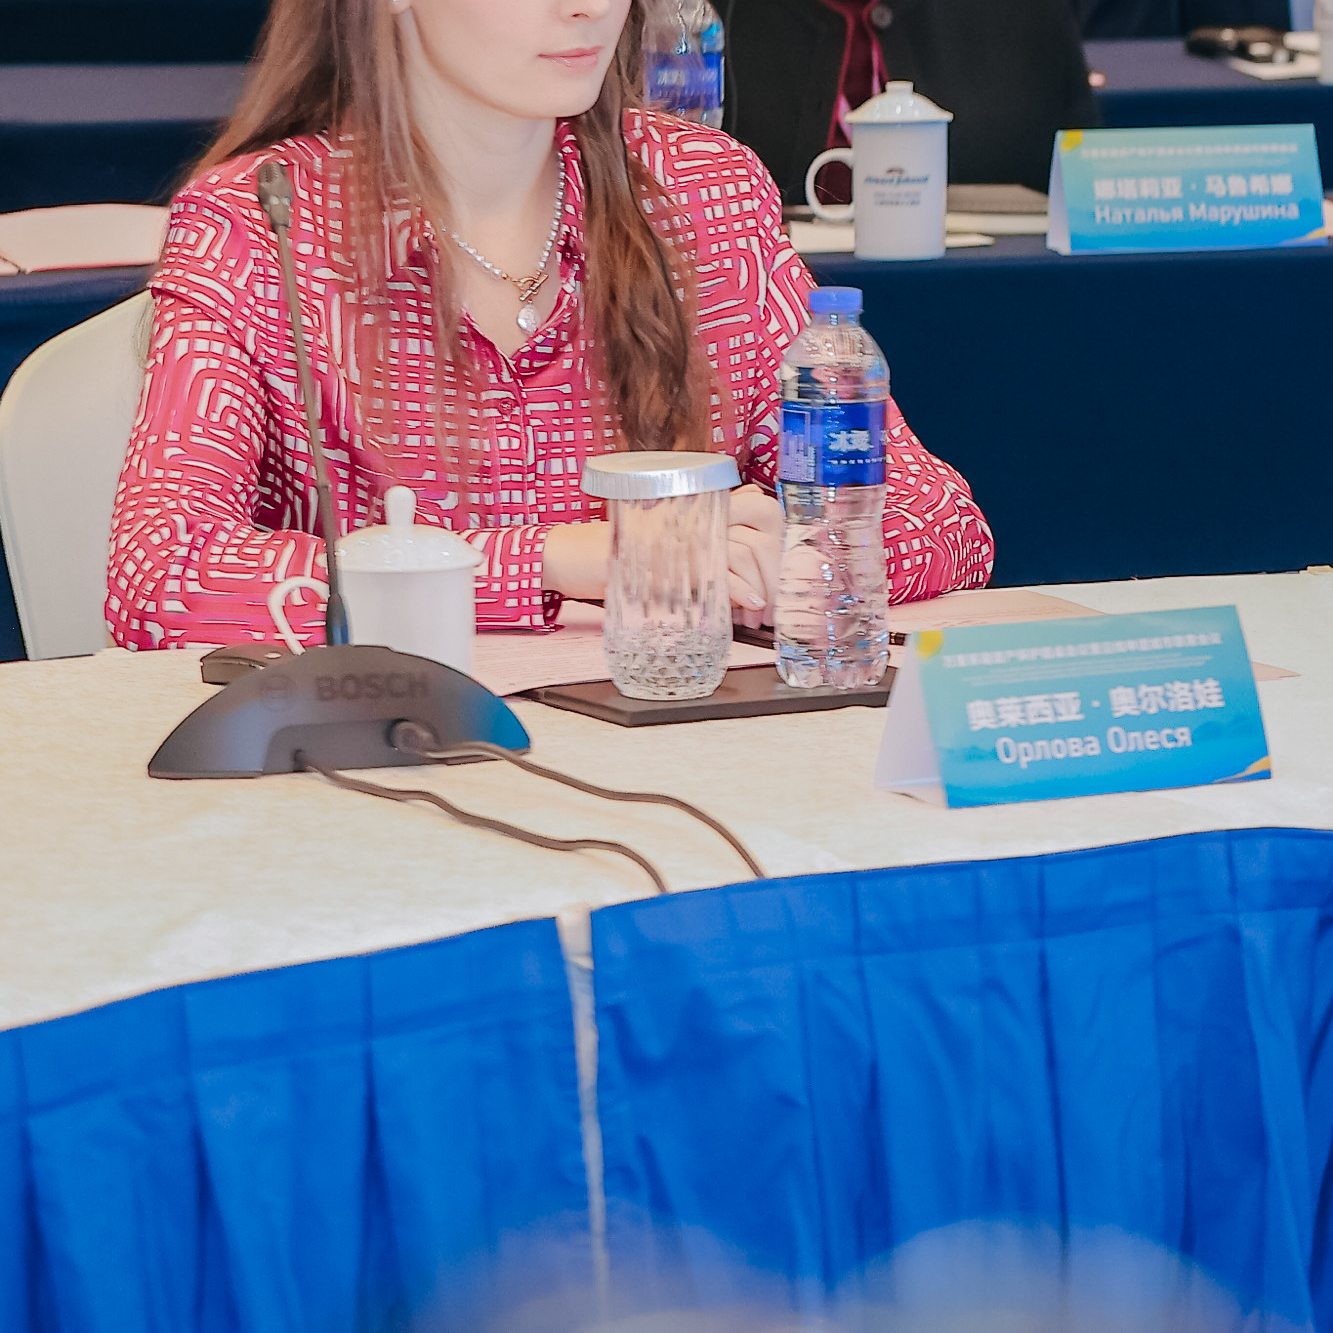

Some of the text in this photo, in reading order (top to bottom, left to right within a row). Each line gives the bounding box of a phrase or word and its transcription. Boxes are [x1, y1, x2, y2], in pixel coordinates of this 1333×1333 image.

[1095, 204, 1184, 224] Наталья
[315, 673, 430, 701] BOSCH
[995, 726, 1193, 769] Орлова Олеся
